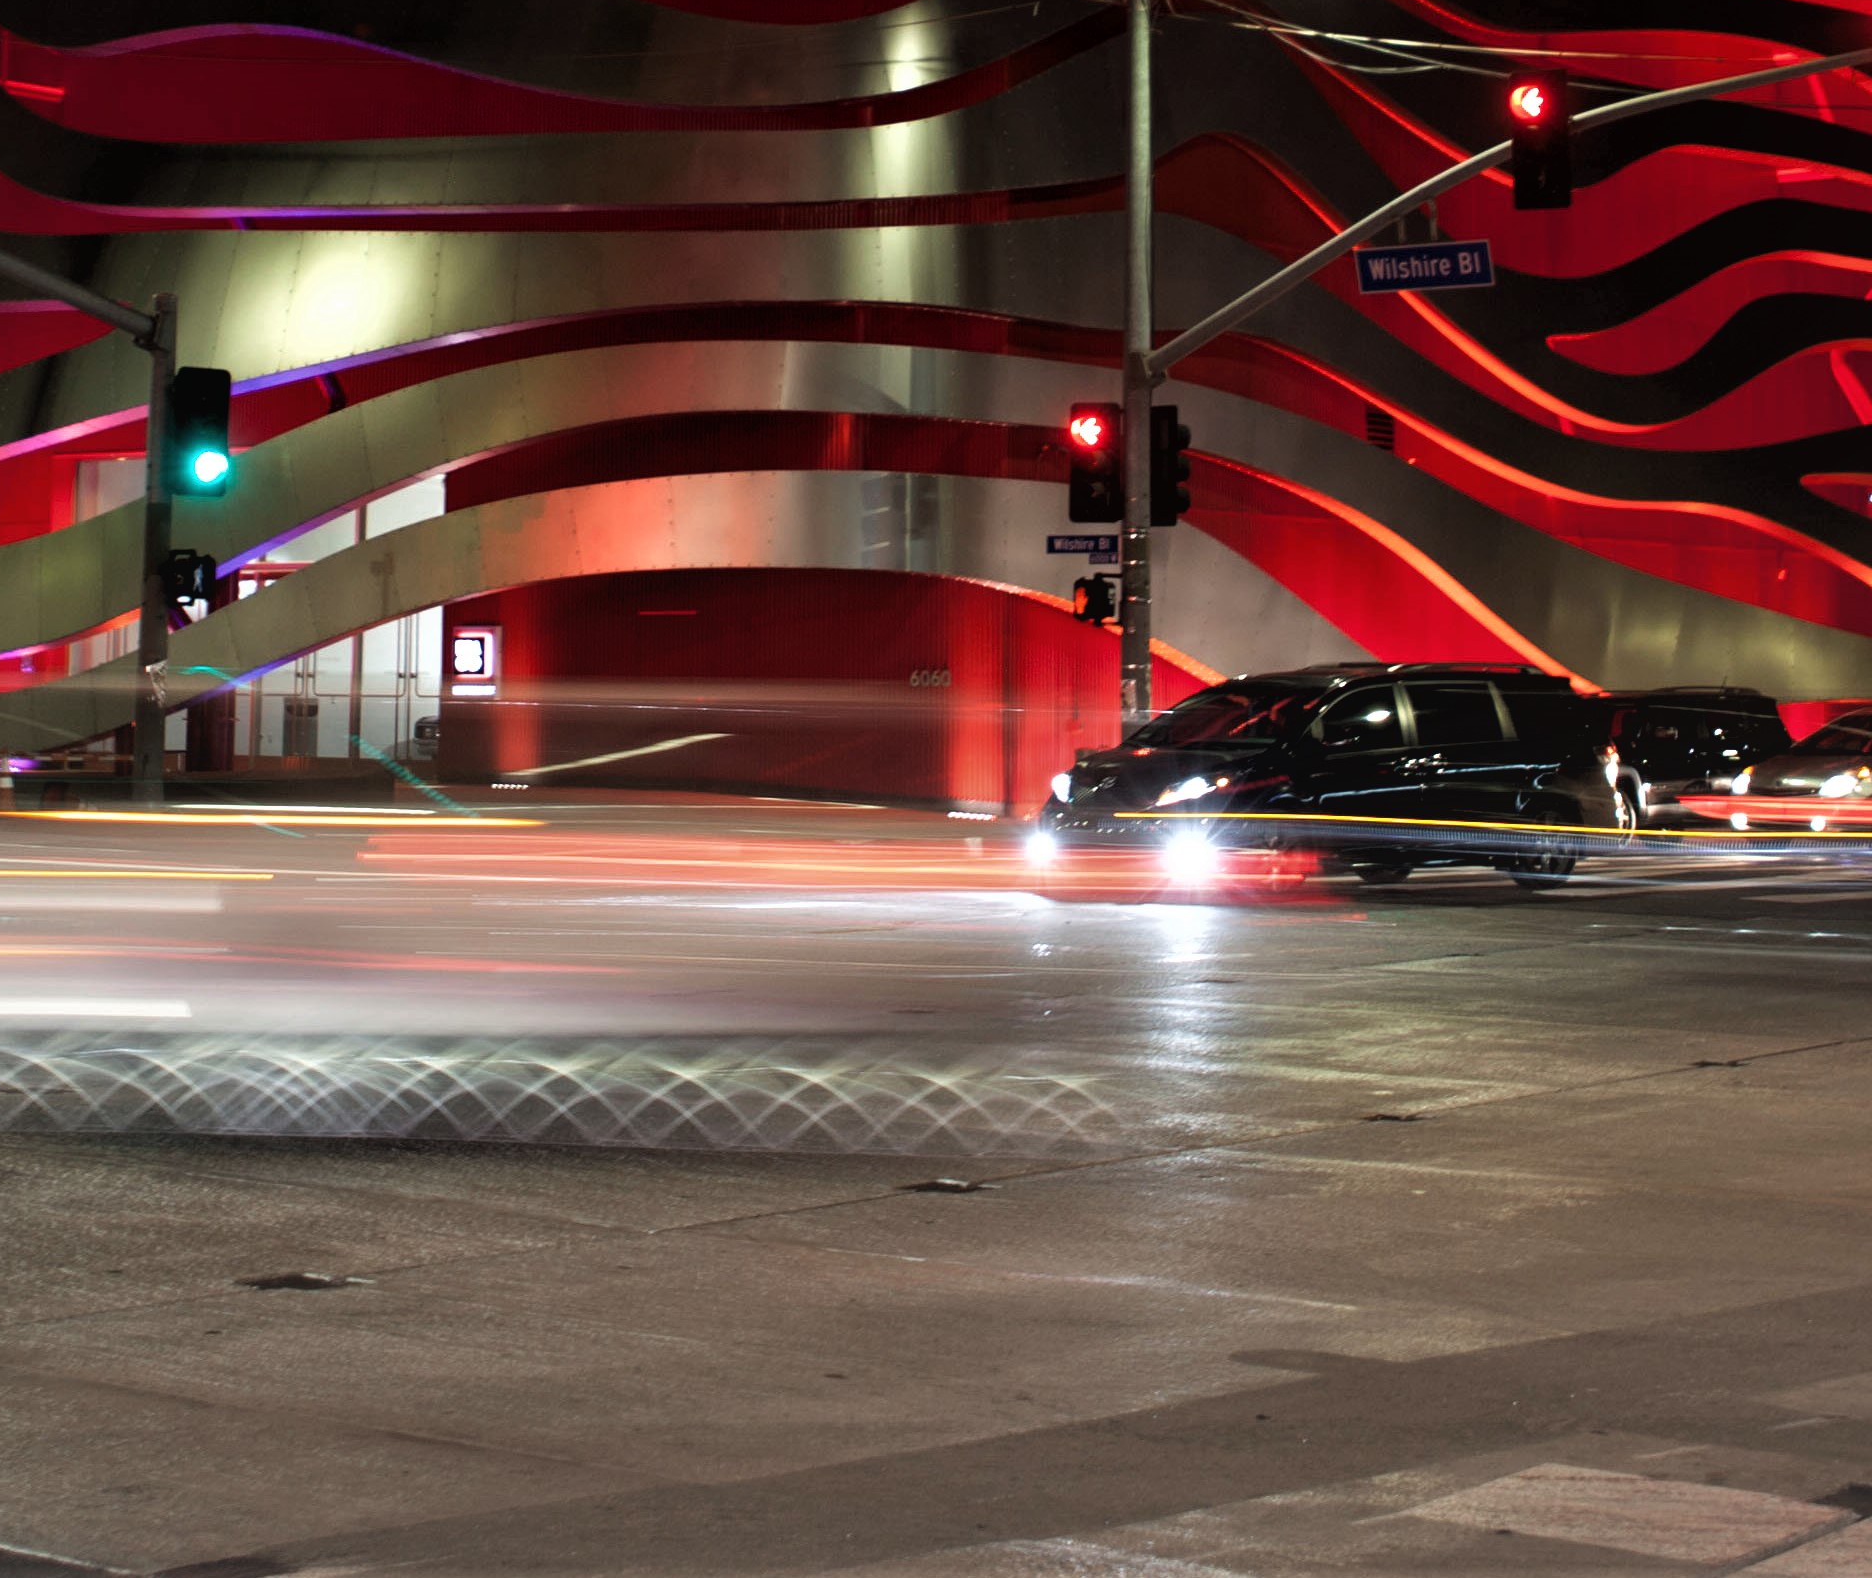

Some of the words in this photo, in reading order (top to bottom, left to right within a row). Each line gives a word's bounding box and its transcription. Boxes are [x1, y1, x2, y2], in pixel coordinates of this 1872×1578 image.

[1368, 255, 1451, 280] Wilshire
[1458, 251, 1481, 275] Bl
[1053, 537, 1095, 551] Wilshire
[910, 669, 952, 687] 6060
